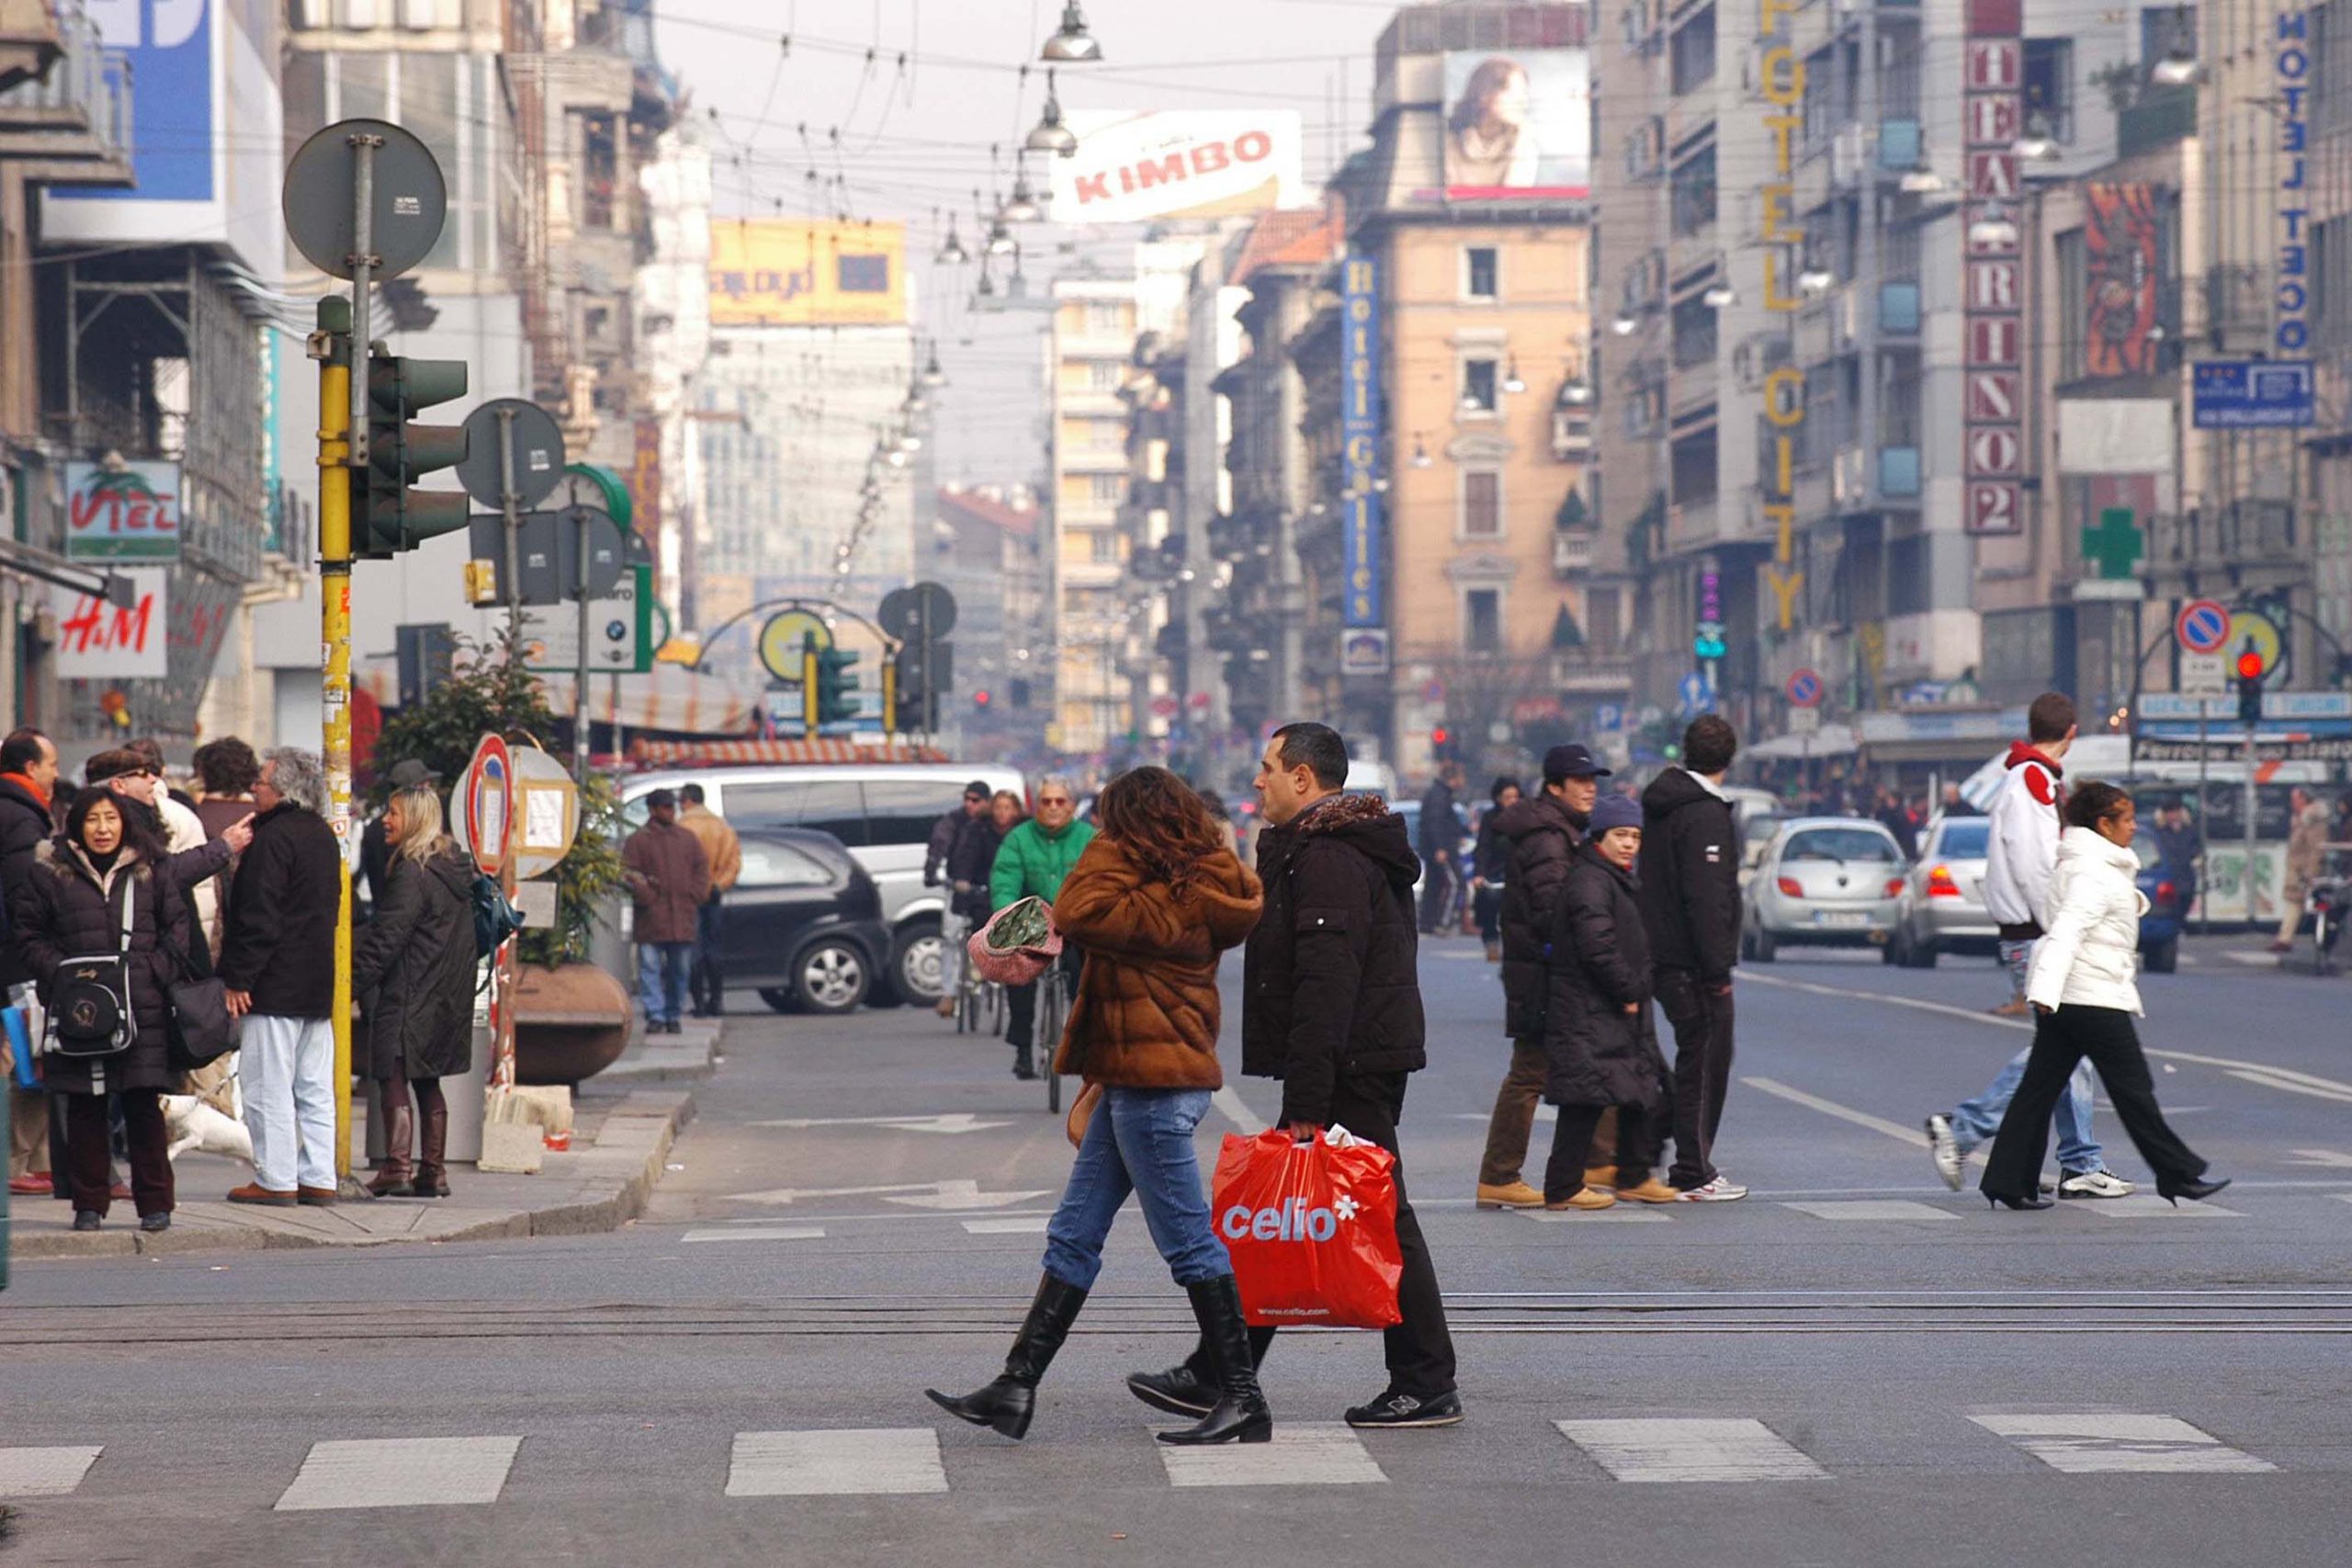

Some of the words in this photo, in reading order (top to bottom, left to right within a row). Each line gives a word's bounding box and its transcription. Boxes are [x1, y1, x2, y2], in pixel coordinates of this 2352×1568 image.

[1074, 130, 1272, 204] KIMBO
[1347, 261, 1374, 416] Hotel
[1764, 365, 1805, 630] CITY
[61, 593, 154, 653] H&M
